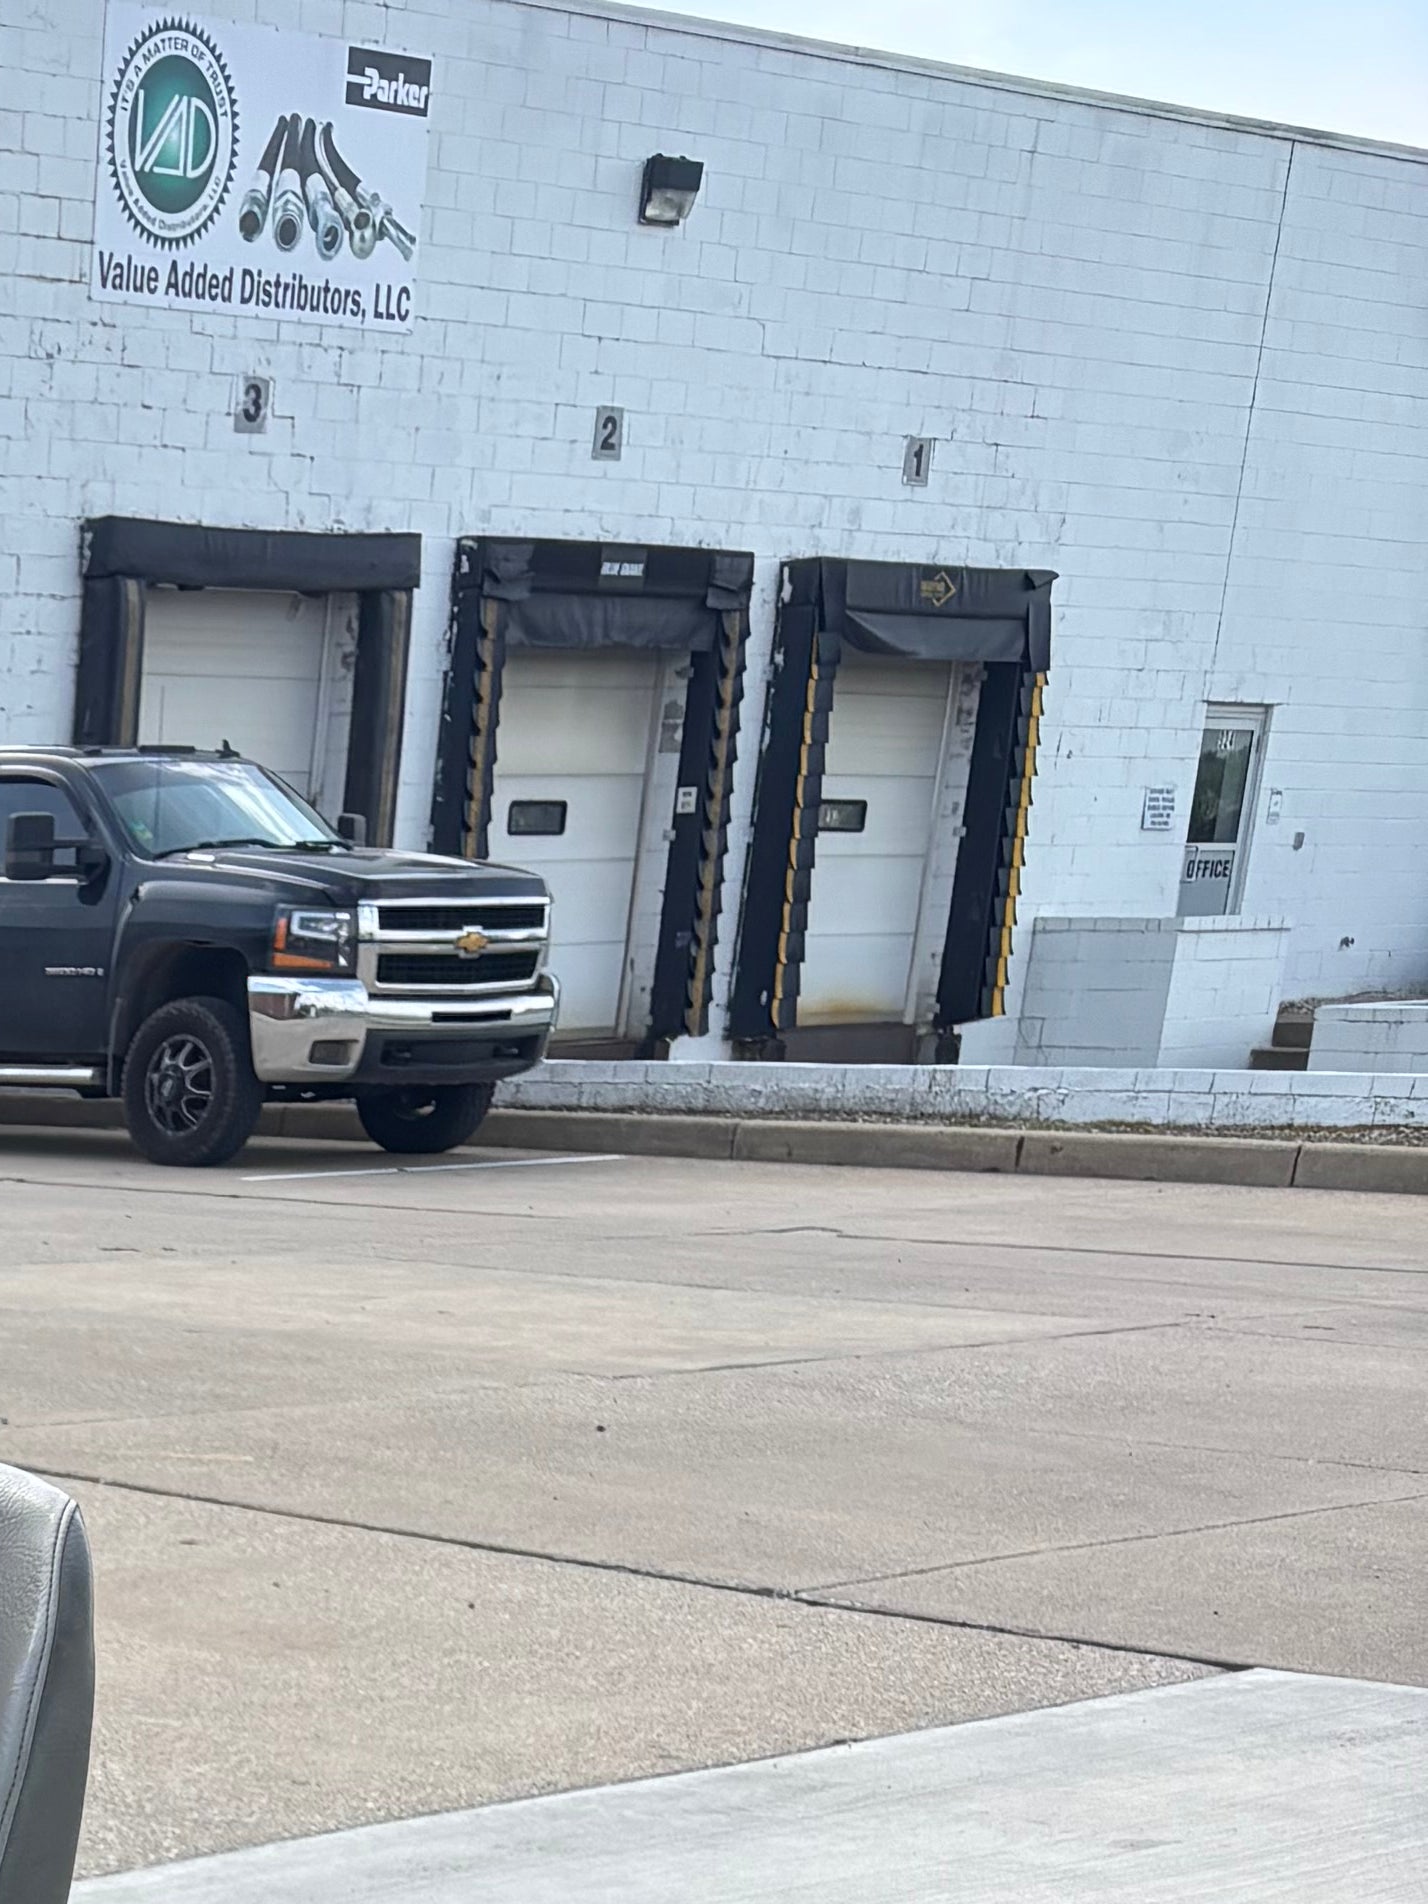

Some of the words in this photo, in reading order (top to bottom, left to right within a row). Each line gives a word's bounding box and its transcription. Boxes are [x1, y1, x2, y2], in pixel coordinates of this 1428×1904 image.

[142, 36, 189, 64] MATTER
[190, 44, 206, 62] OF
[362, 66, 429, 109] Parker
[98, 250, 159, 295] Value
[164, 258, 234, 303] Added
[240, 268, 366, 325] Distributors,
[373, 283, 412, 322] LLC
[244, 383, 263, 423] 3
[600, 415, 618, 451] 2
[913, 444, 925, 477] 1
[1186, 859, 1230, 879] OFFICE
